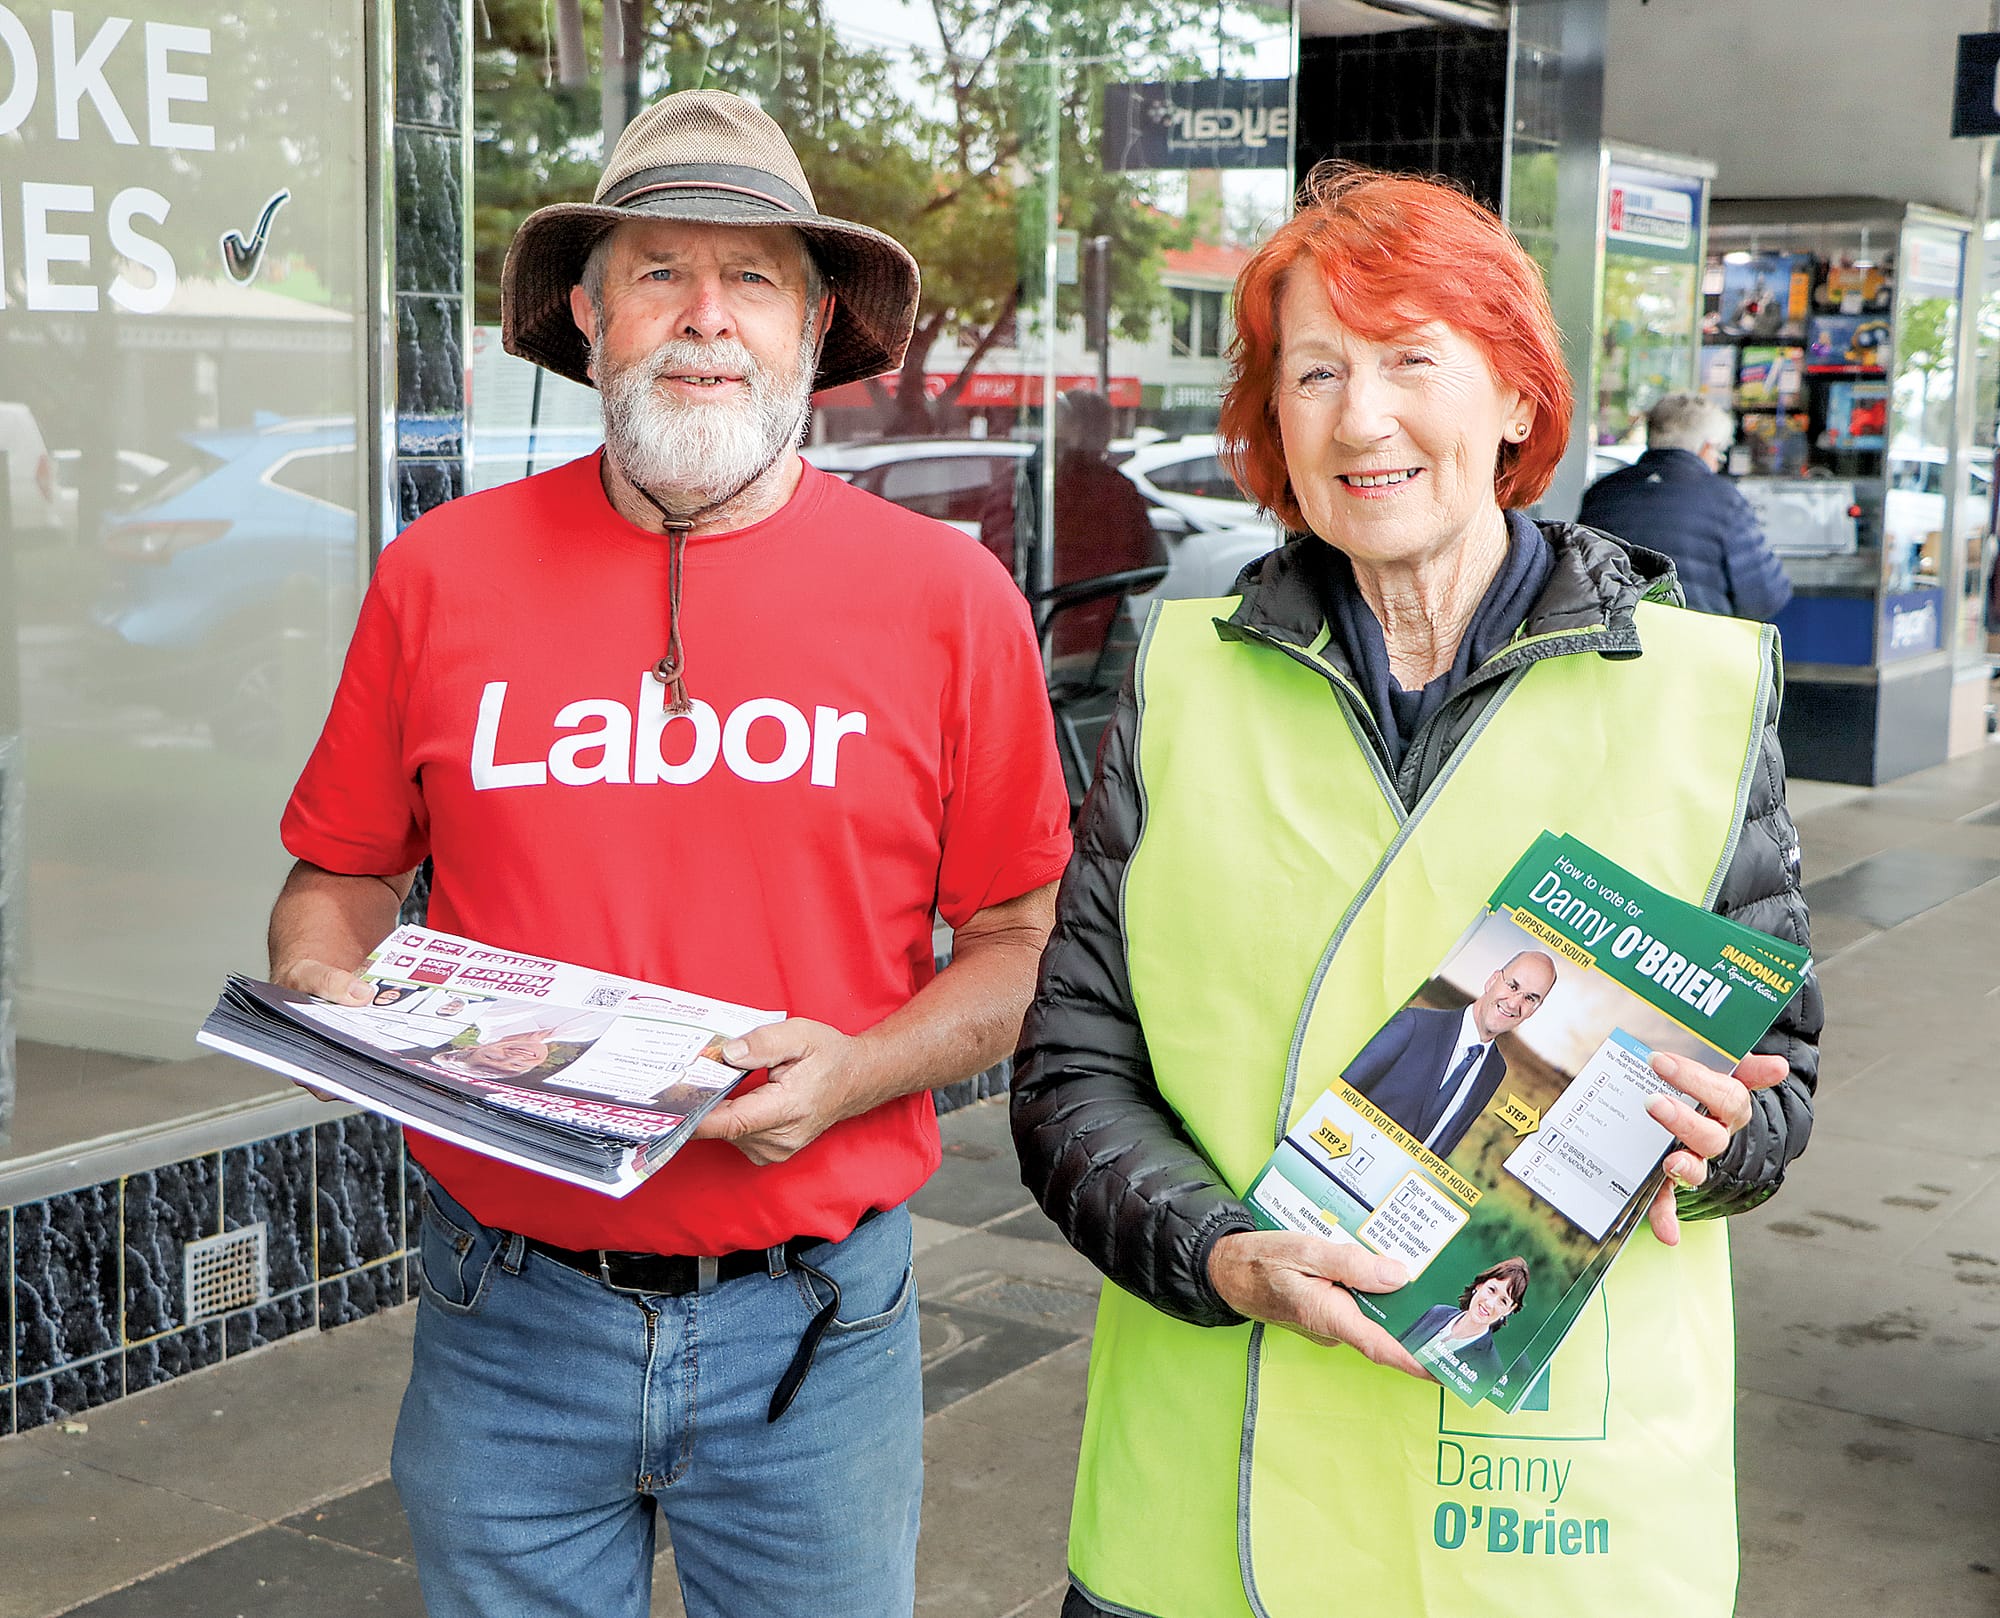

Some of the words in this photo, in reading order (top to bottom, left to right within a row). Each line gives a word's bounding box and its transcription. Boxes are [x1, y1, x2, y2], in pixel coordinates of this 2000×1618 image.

[0, 181, 177, 314] ES
[470, 671, 868, 790] Labor
[1553, 854, 1584, 880] How
[1581, 873, 1599, 890] to
[1594, 884, 1625, 907] vote
[1622, 899, 1644, 919] for
[1514, 911, 1563, 948] GIPPSLAND
[1560, 942, 1591, 967] SOUTH
[1527, 870, 1617, 946] Danny
[1610, 924, 1733, 1017] O'BRIEN
[422, 958, 458, 970] Labor
[462, 967, 552, 987] Matters
[1724, 947, 1794, 994] NATIONALS
[454, 978, 493, 989] What
[493, 982, 549, 997] Doing
[1605, 1050, 1615, 1060] You
[1614, 1057, 1628, 1069] must
[1627, 1066, 1646, 1081] number
[1644, 1079, 1658, 1090] every
[1619, 1050, 1648, 1072] Gippsland
[471, 1081, 577, 1106] Gippsland
[1622, 1073, 1635, 1082] your
[1634, 1080, 1646, 1090] vote
[574, 1110, 663, 1133] Denise
[578, 1102, 611, 1112] for
[613, 1108, 674, 1125] Labor
[1504, 1104, 1527, 1123] STEP
[575, 1119, 599, 1128] TO
[602, 1125, 650, 1139] HOW
[1318, 1126, 1340, 1146] STEP
[1337, 1142, 1347, 1152] 2
[1340, 1087, 1363, 1108] HOW
[1360, 1103, 1375, 1118] TO
[1372, 1113, 1395, 1135] VOTE
[1392, 1130, 1406, 1143] IN
[1403, 1138, 1422, 1157] THE
[1419, 1152, 1449, 1179] UPPER
[1446, 1174, 1478, 1202] HOUSE
[1556, 1148, 1568, 1159] THE
[1566, 1156, 1593, 1179] NATIONALS
[1585, 1159, 1603, 1176] Danny
[1270, 1197, 1283, 1210] The
[1280, 1206, 1307, 1232] Nationals
[1387, 1200, 1402, 1215] You
[1399, 1211, 1411, 1223] do
[1408, 1219, 1423, 1232] not
[1406, 1178, 1427, 1198] Place
[1424, 1194, 1432, 1202] a
[1429, 1198, 1458, 1223] number
[1409, 1201, 1419, 1212] in
[1416, 1208, 1432, 1223] Box
[1429, 1219, 1440, 1230] C.
[1298, 1206, 1332, 1238] REMEMBER
[1380, 1209, 1398, 1226] need
[1396, 1223, 1406, 1233] to
[1403, 1229, 1432, 1254] number
[1366, 1226, 1379, 1239] the
[1377, 1236, 1392, 1250] line
[1372, 1218, 1387, 1233] any
[1386, 1229, 1400, 1242] box
[1398, 1239, 1419, 1259] under
[1420, 1345, 1441, 1366] Eastern
[1437, 1361, 1457, 1380] Victoria
[1453, 1376, 1473, 1396] Region
[1433, 1339, 1461, 1367] Melina
[1457, 1360, 1480, 1383] Bath
[1437, 1439, 1572, 1504] Danny
[1434, 1501, 1609, 1555] O'Brien
